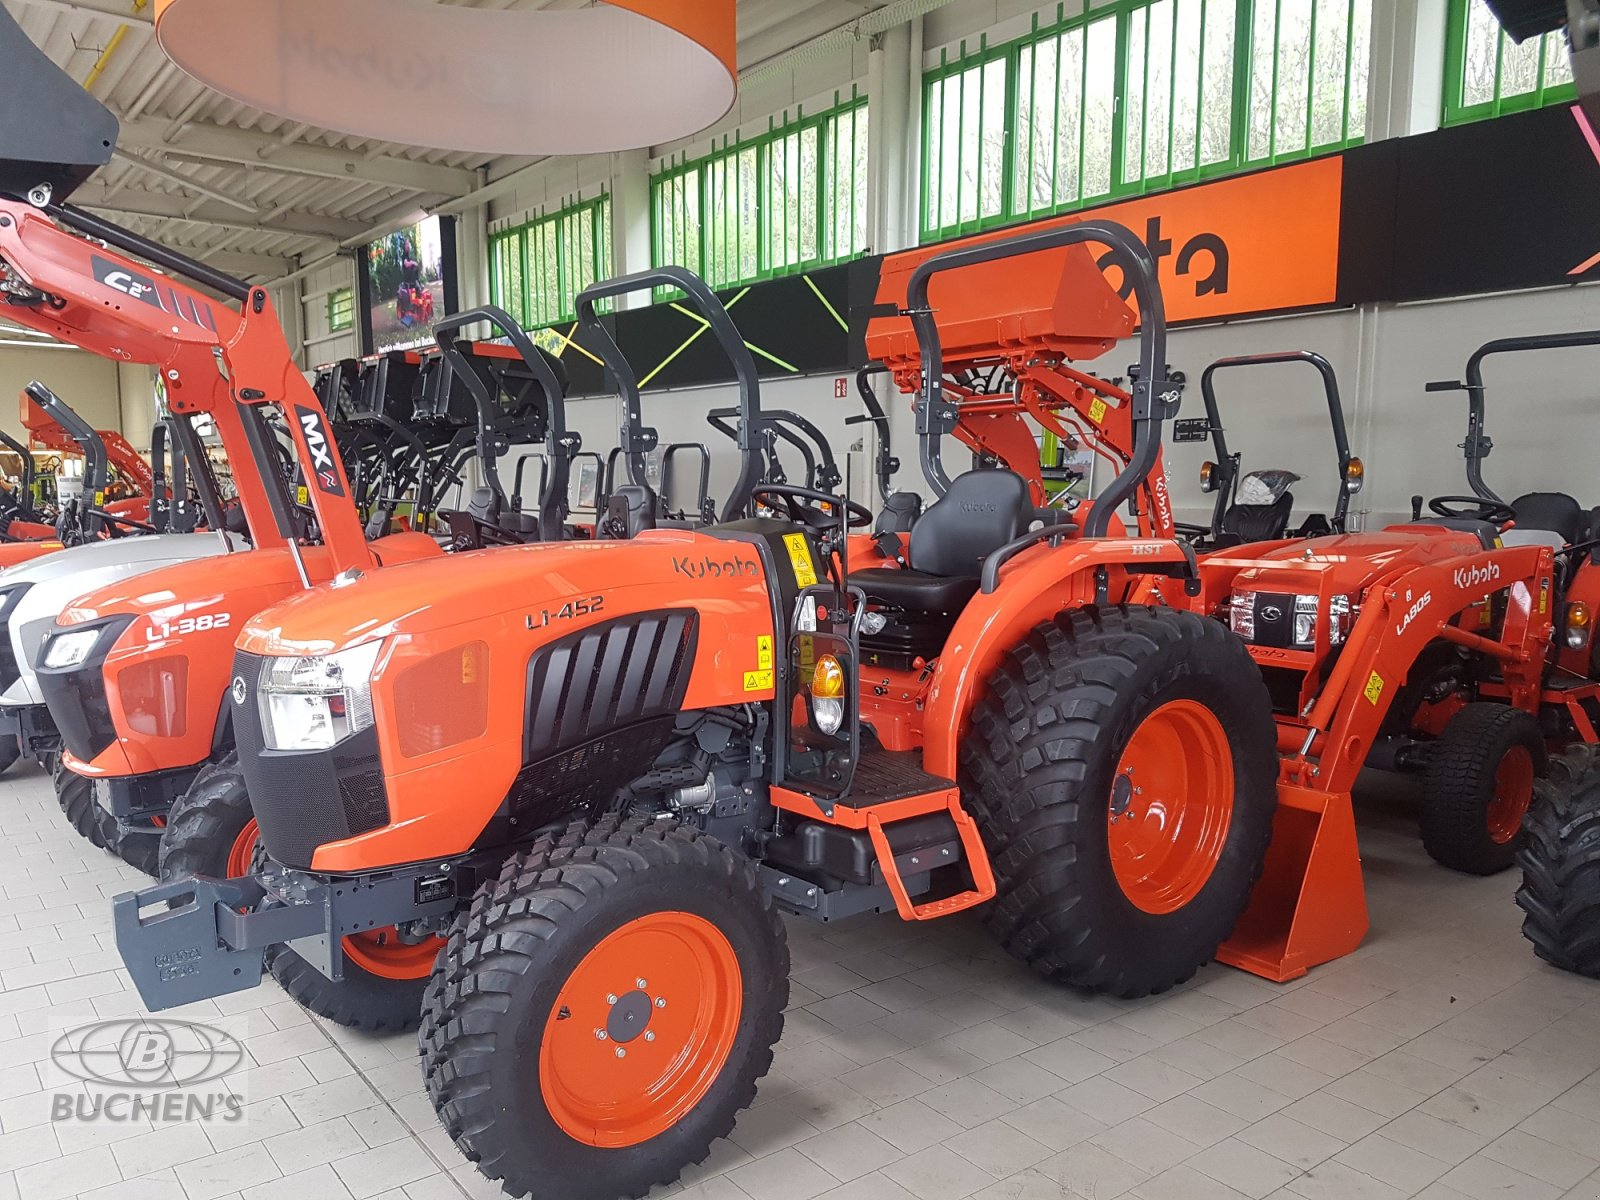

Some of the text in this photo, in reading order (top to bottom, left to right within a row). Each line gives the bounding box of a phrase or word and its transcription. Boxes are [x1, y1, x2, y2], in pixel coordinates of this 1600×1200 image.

[301, 413, 333, 470] MX
[1155, 476, 1170, 530] Kubota
[1131, 544, 1163, 556] HST
[672, 555, 759, 579] Kubota
[1453, 560, 1500, 589] Kubota
[146, 613, 230, 641] L1-382
[526, 595, 604, 630] L1-452
[1396, 590, 1432, 636] LA805
